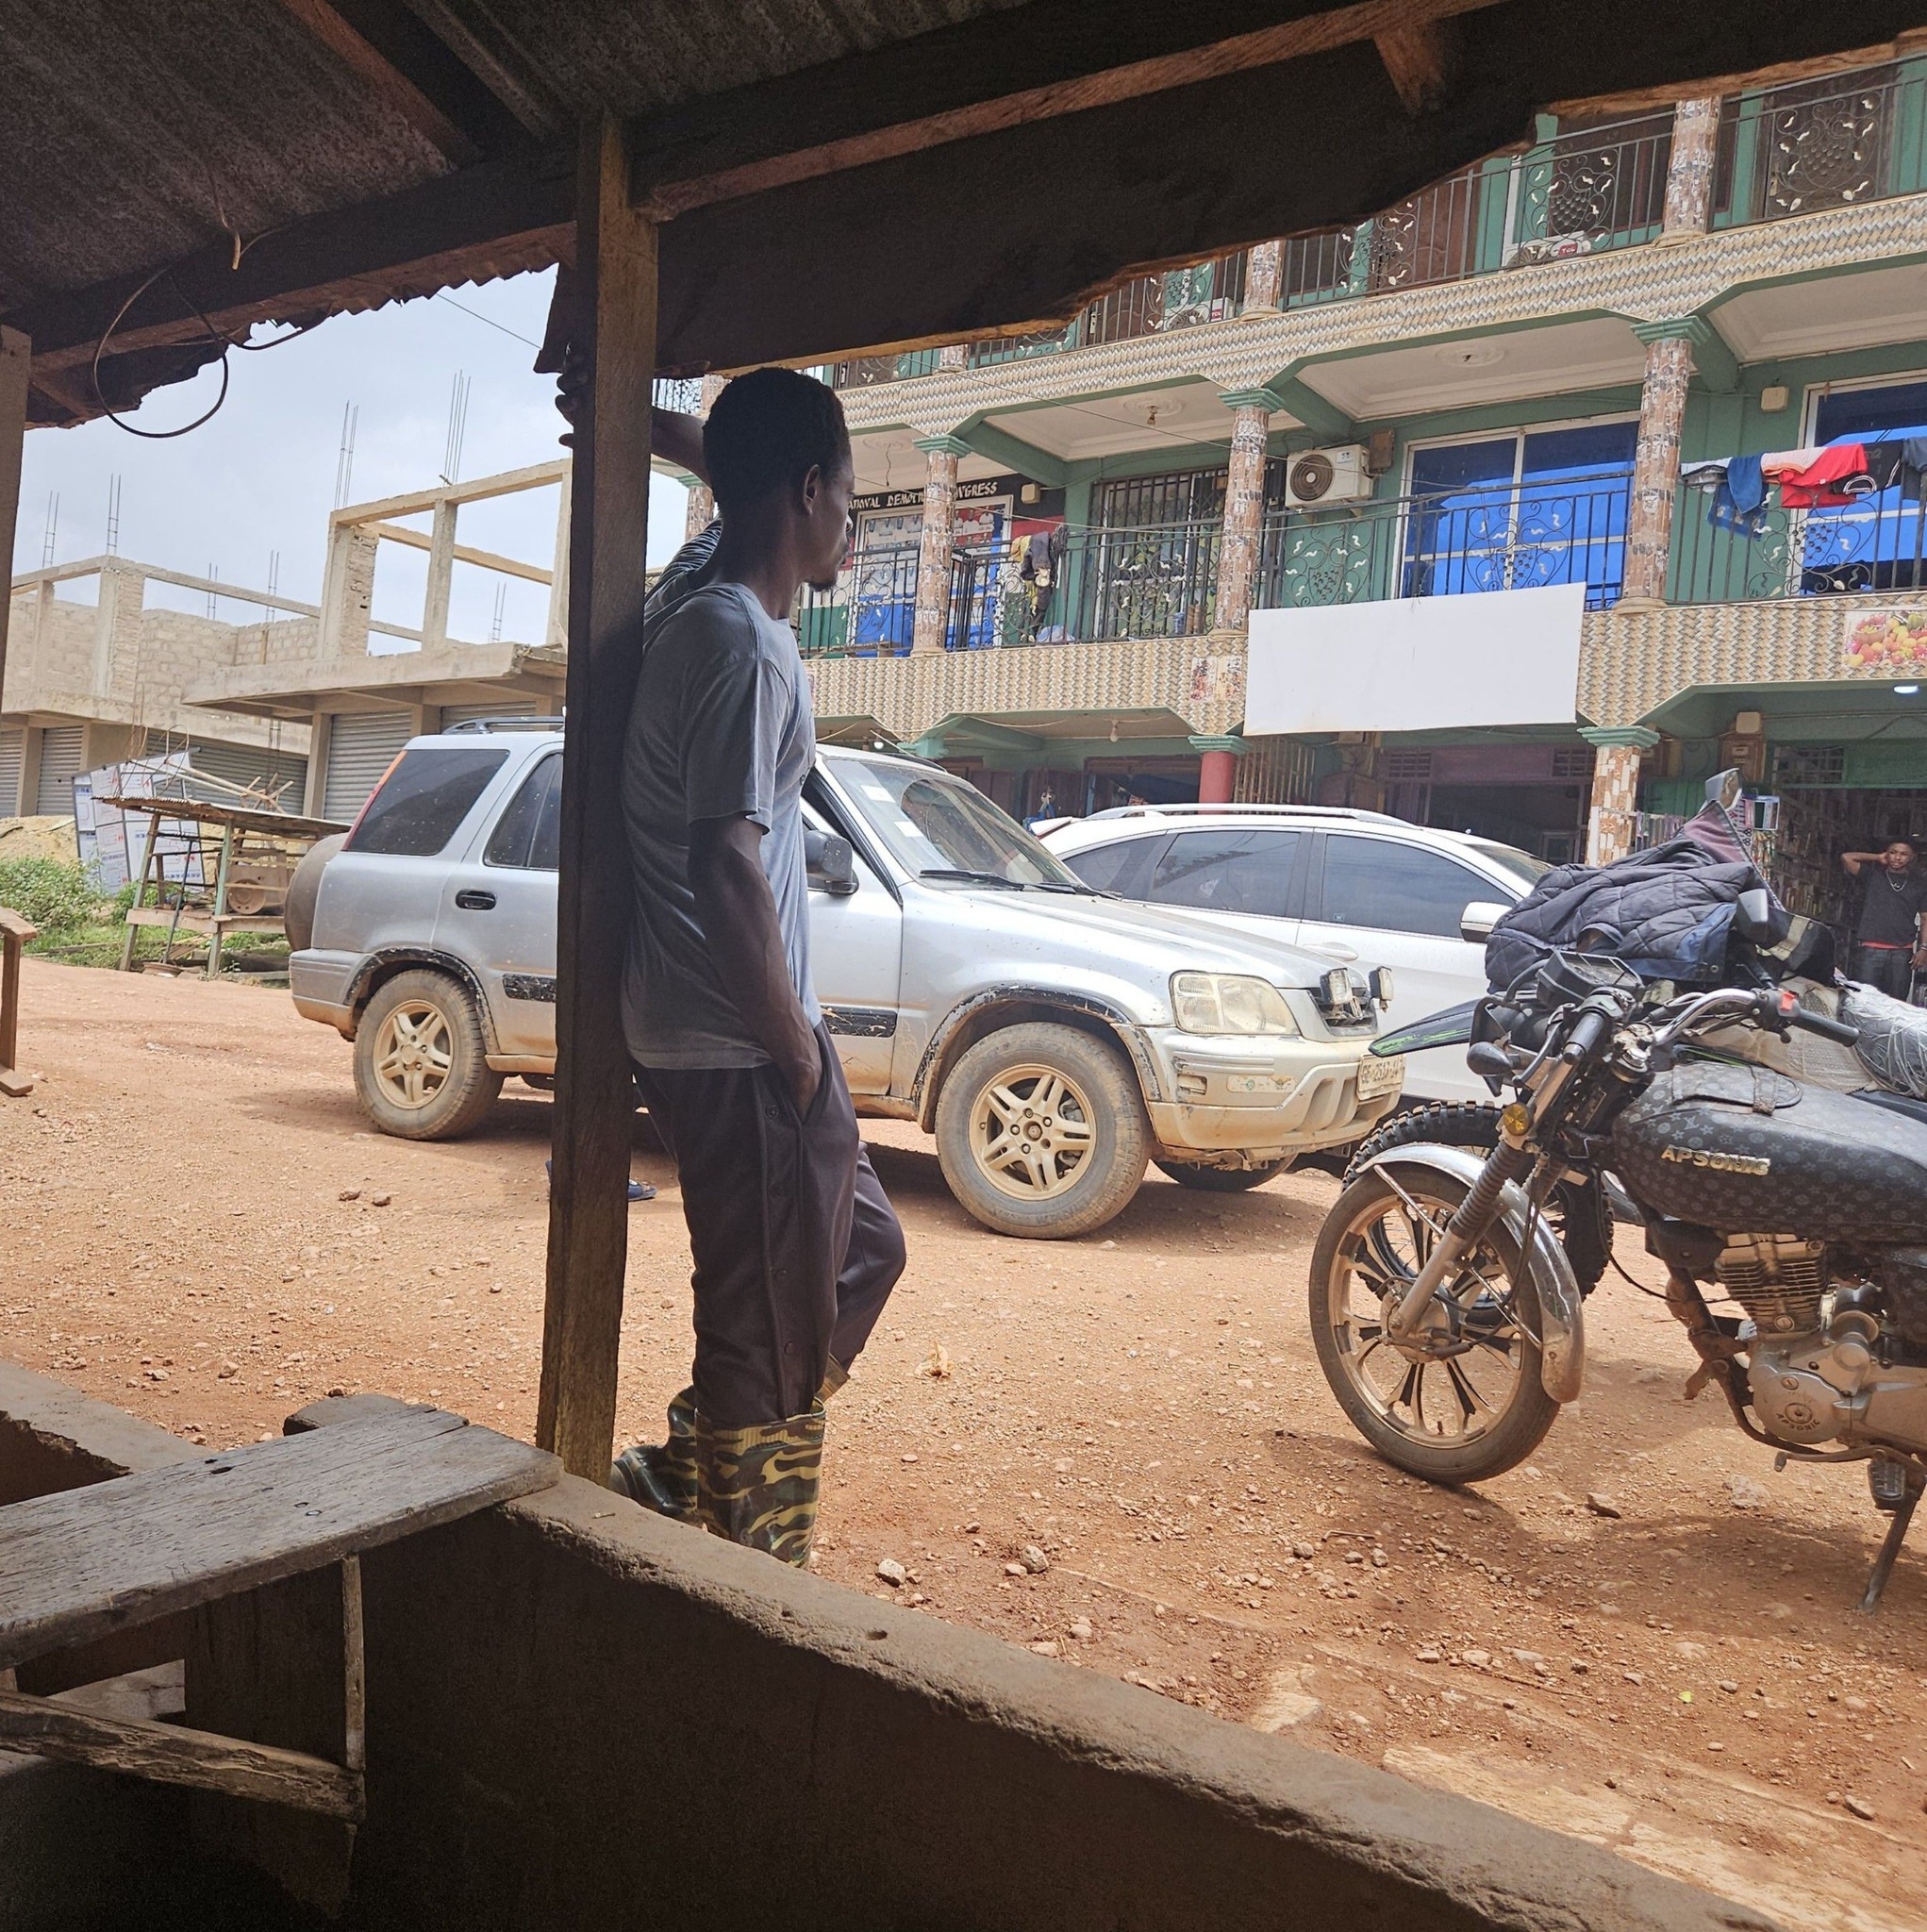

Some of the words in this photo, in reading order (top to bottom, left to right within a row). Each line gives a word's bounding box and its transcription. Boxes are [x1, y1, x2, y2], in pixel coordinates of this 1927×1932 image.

[848, 496, 881, 510] ATIONAL
[955, 481, 998, 499] NGRESS
[1660, 1143, 1771, 1175] APSONIC
[1775, 1412, 1820, 1432] APSONIC
